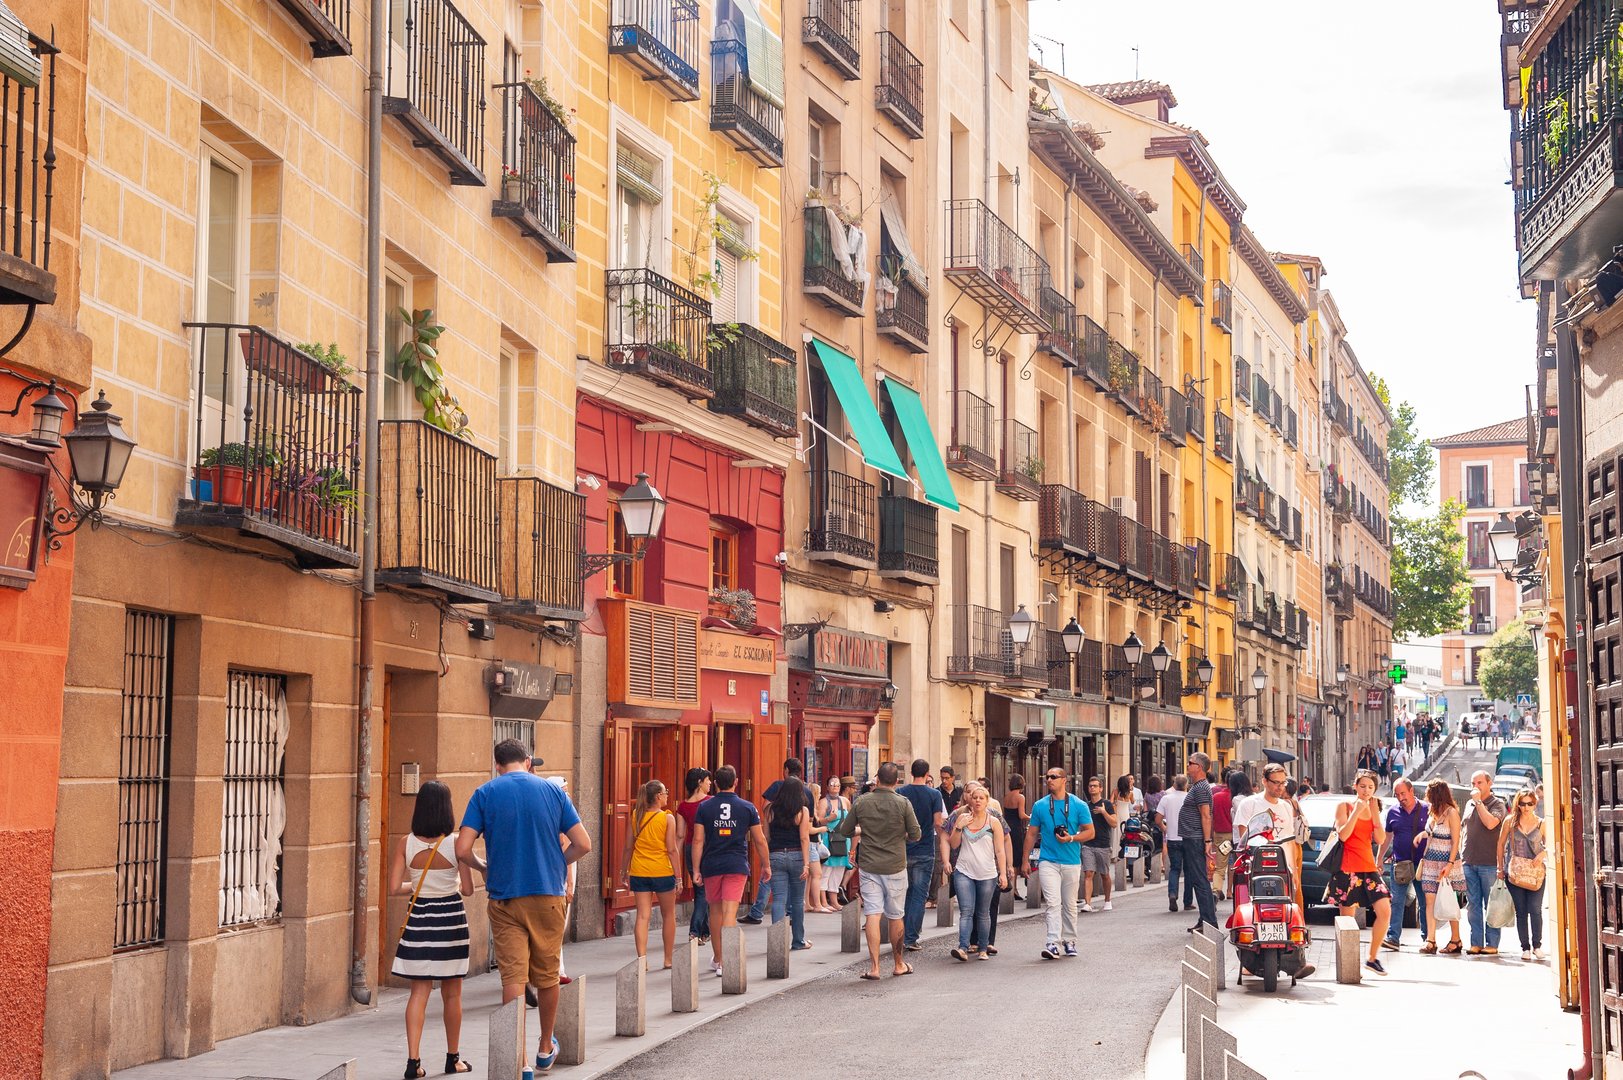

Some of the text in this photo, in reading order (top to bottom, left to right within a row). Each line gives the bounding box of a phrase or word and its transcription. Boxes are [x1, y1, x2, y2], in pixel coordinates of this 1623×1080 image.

[14, 533, 31, 558] 25
[816, 630, 887, 673] RESTAURANTE
[720, 803, 731, 820] 3
[1261, 932, 1284, 940] 2250
[1272, 924, 1285, 933] NB
